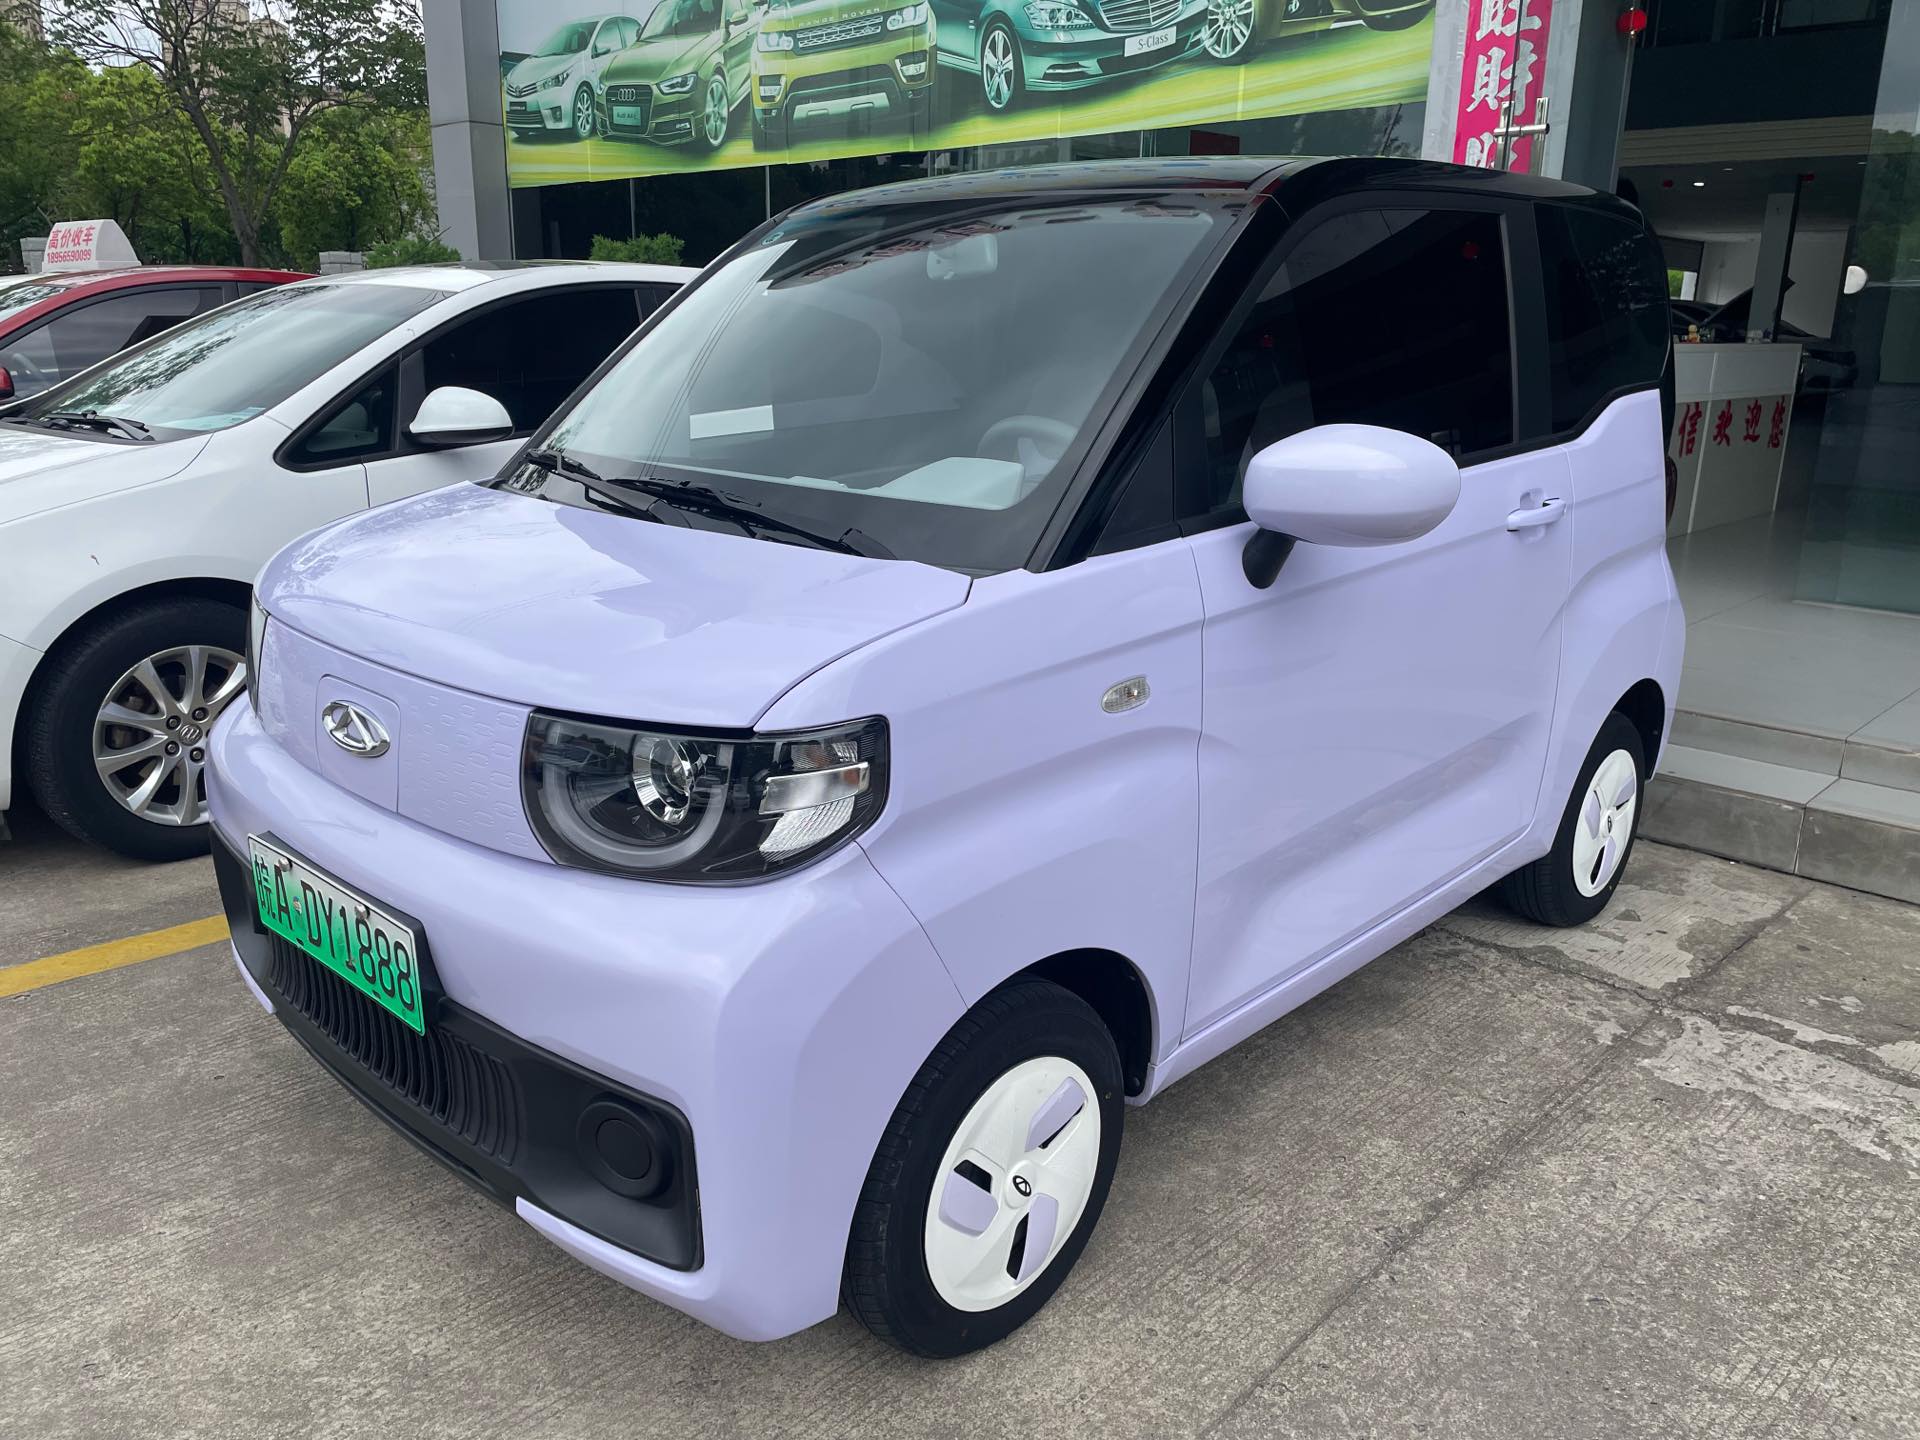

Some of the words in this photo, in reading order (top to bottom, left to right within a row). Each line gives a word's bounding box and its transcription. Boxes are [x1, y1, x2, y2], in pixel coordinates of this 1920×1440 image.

[842, 8, 880, 19] ROVER
[1138, 33, 1169, 50] S-Class
[48, 225, 95, 249] 高价收车
